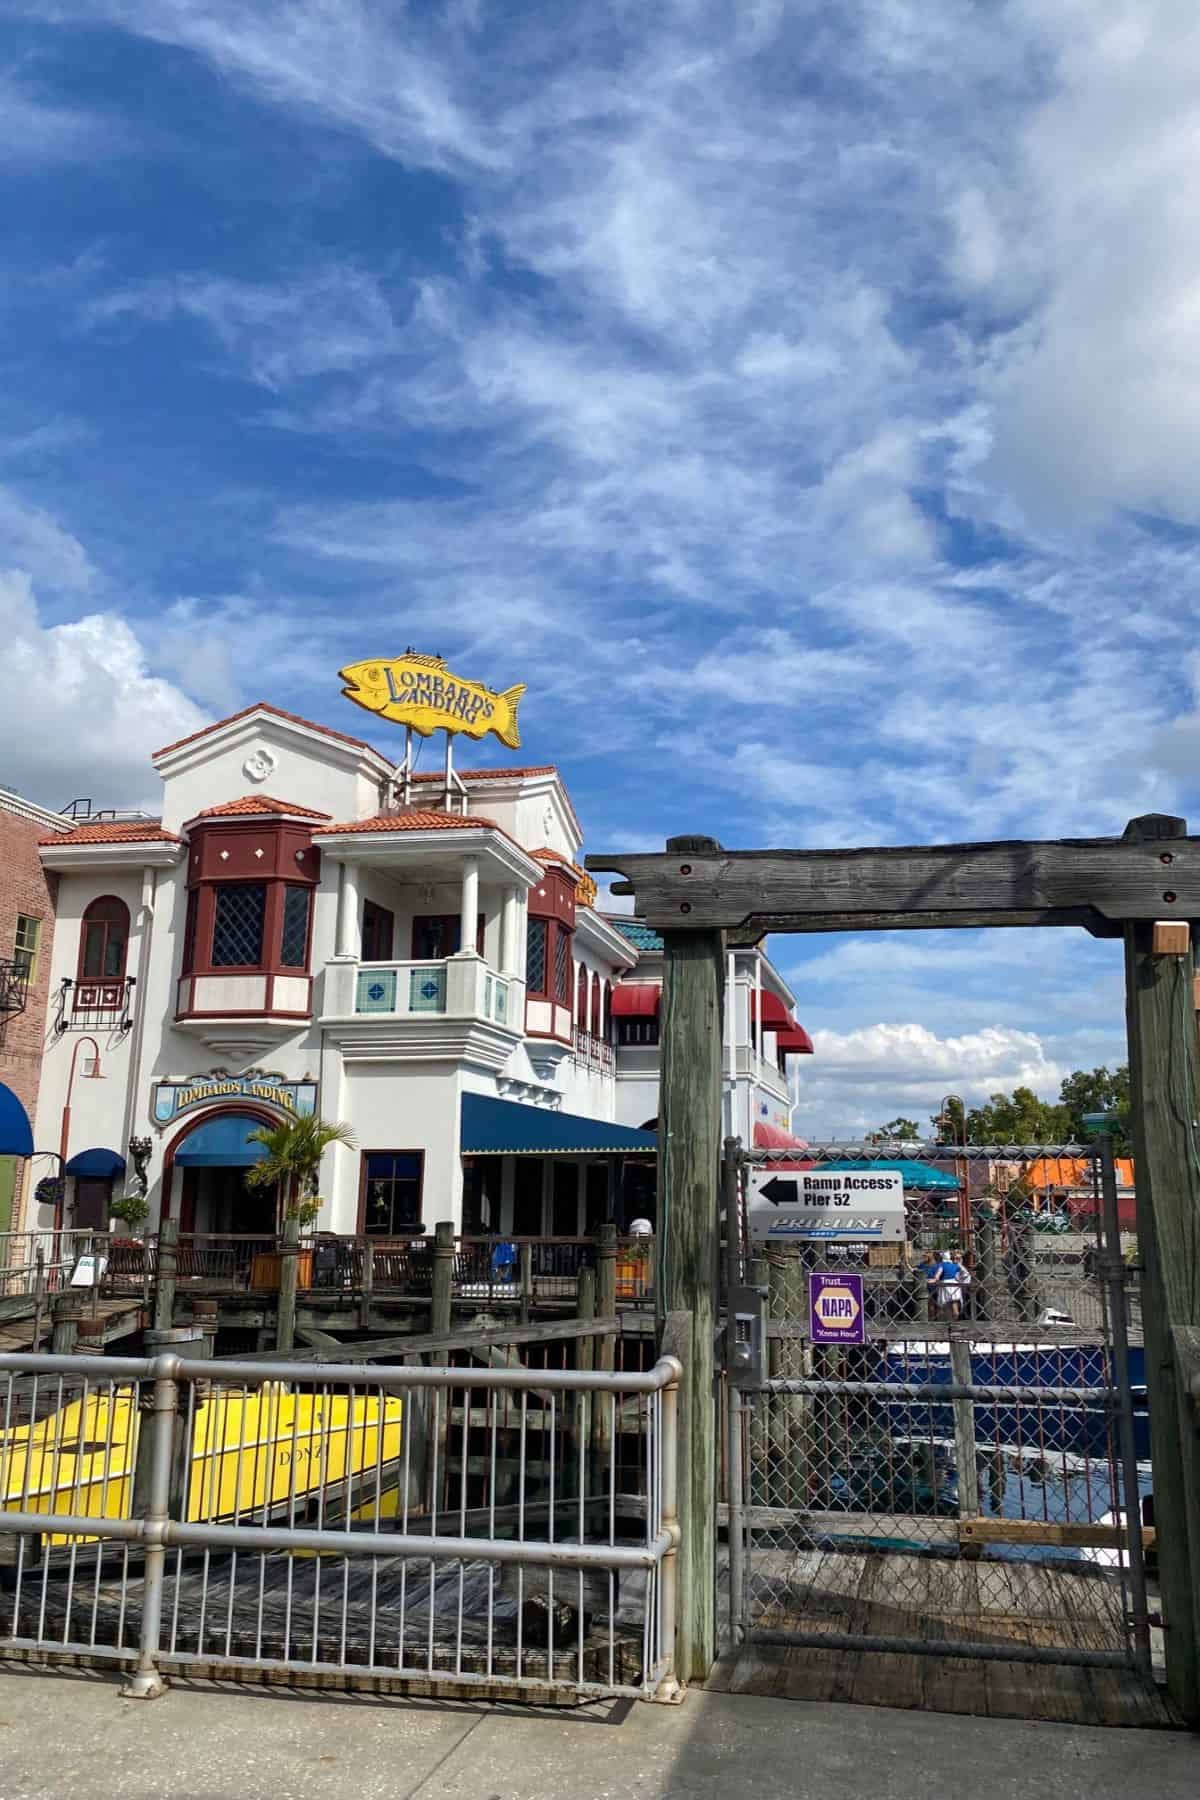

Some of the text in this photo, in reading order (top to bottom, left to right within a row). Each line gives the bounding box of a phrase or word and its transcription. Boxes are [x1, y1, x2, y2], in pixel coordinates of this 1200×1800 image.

[384, 667, 494, 719] LOMBARD'S
[243, 1083, 293, 1111] LANDING
[803, 1177, 893, 1190] Ramp Access
[804, 1194, 850, 1206] Pier 52
[822, 1298, 853, 1317] NAPA
